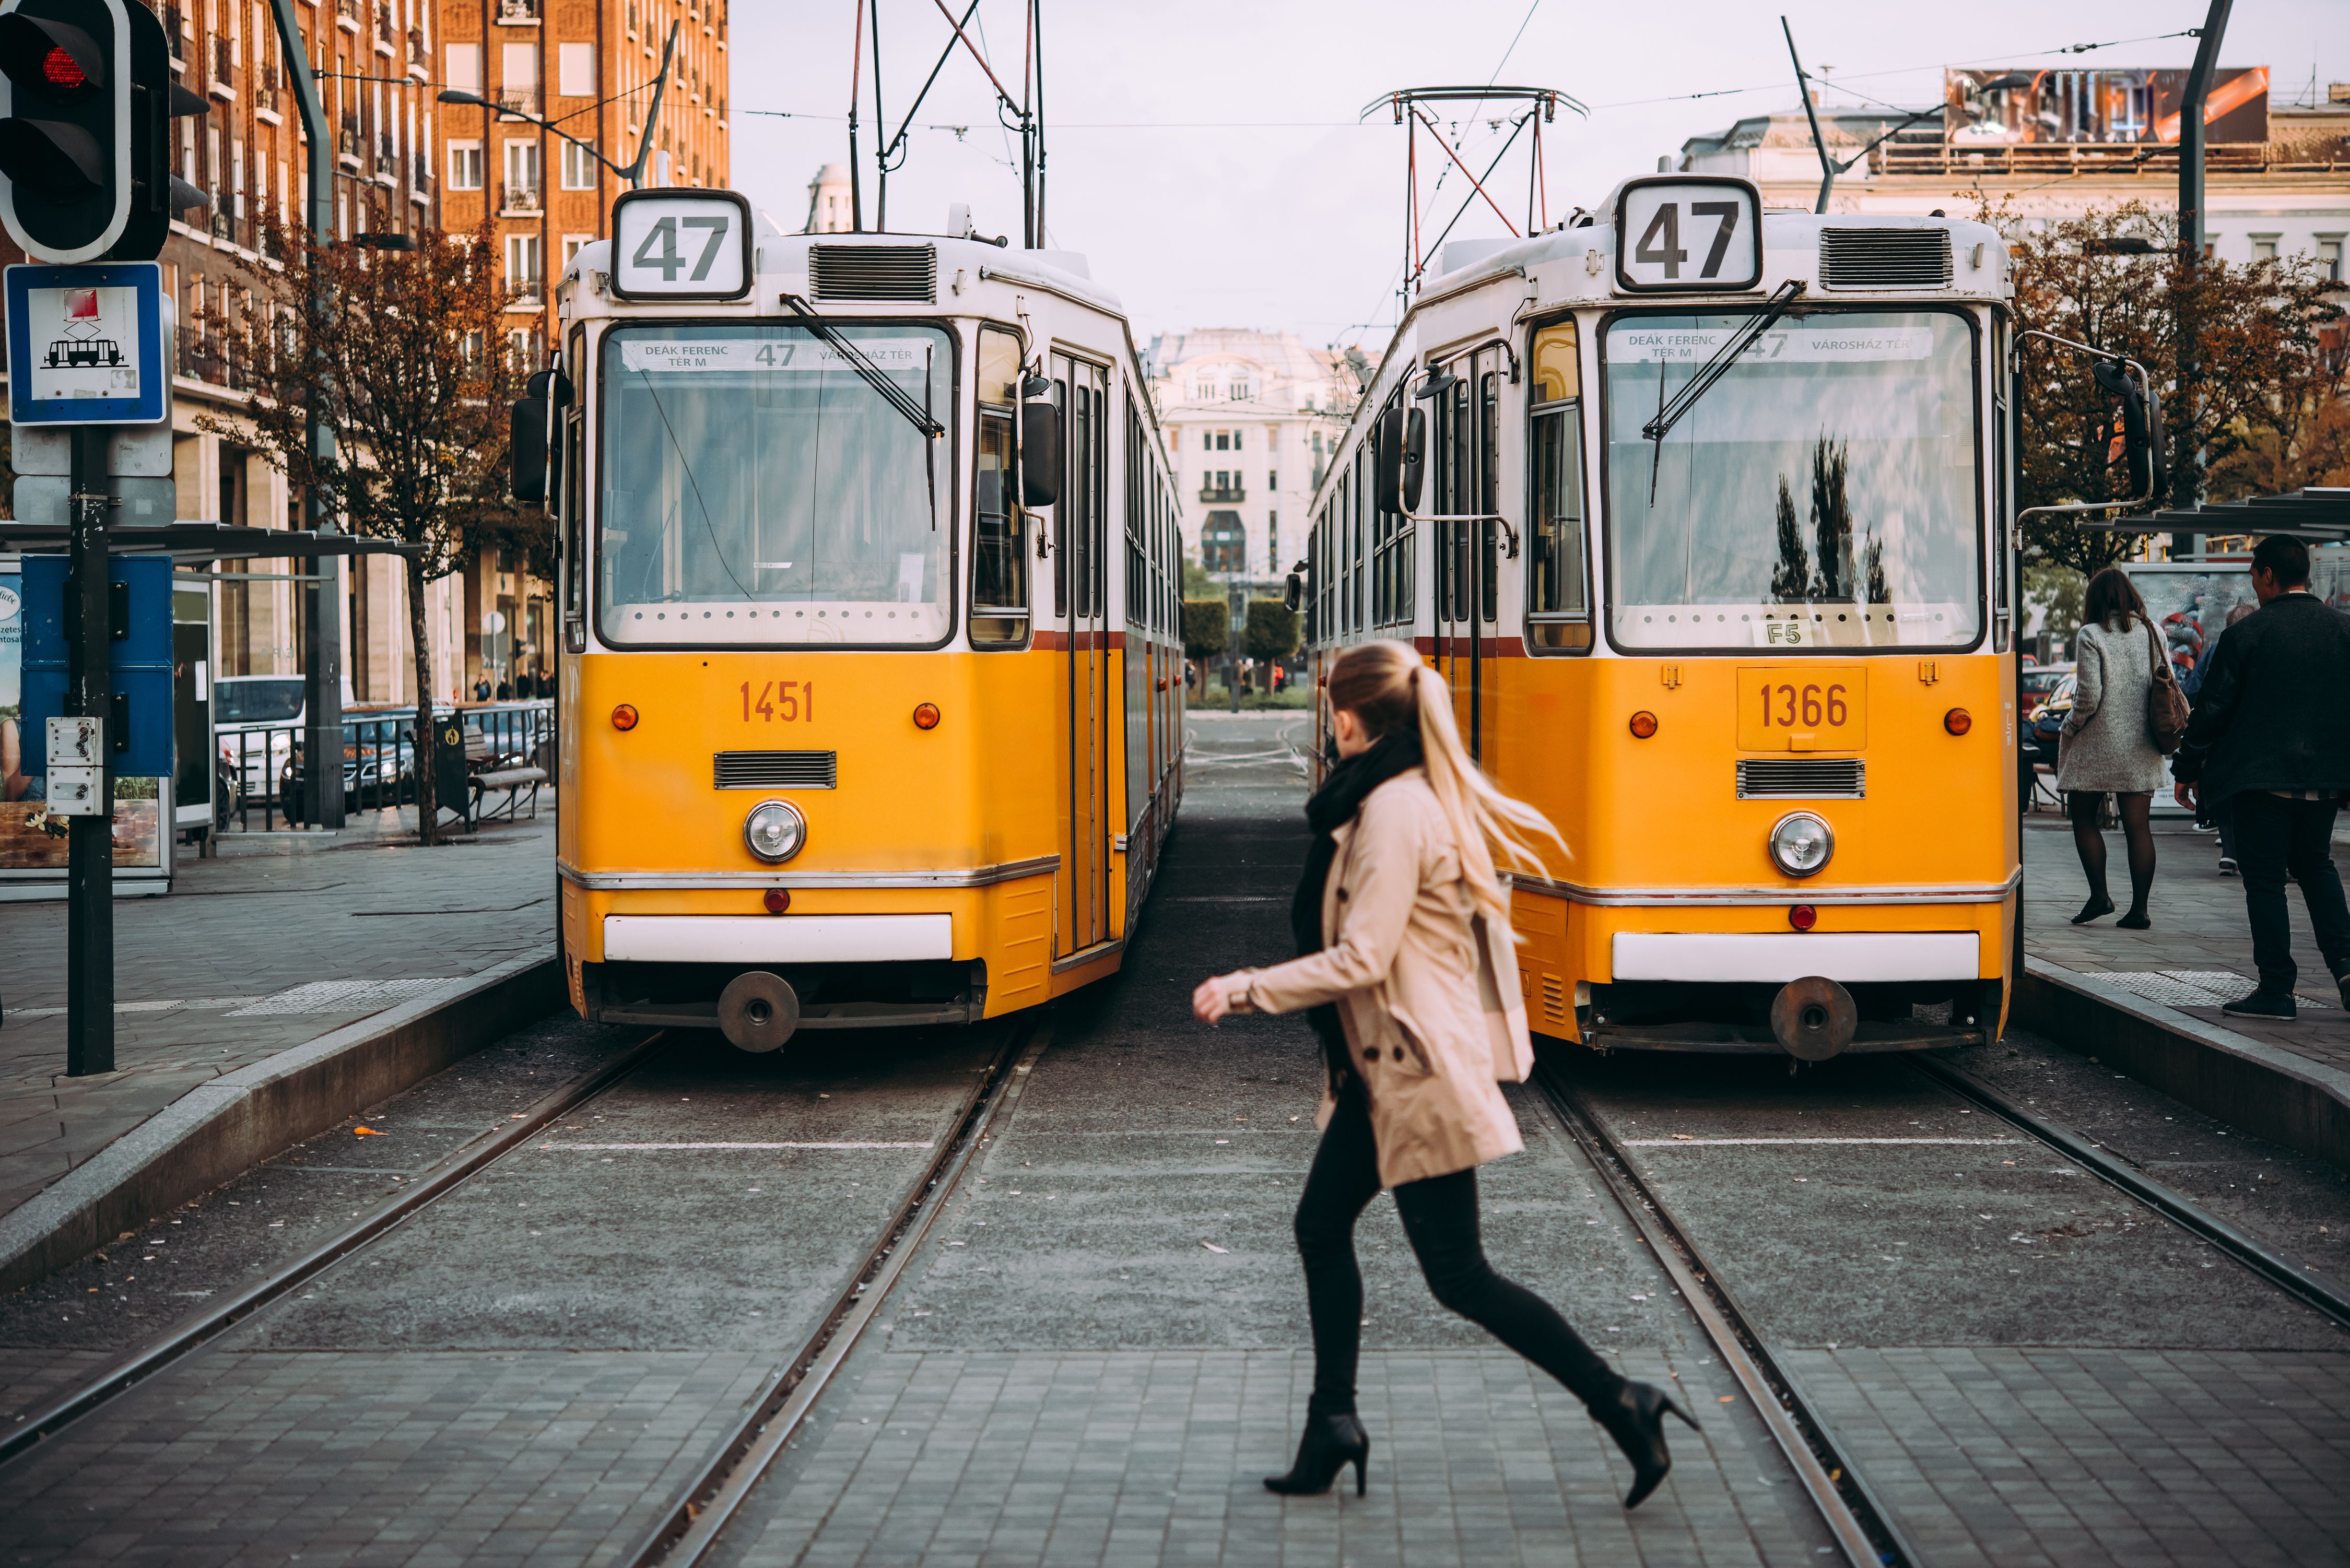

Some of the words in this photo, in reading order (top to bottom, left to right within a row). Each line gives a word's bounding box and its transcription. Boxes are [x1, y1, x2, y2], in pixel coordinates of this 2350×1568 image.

[633, 216, 728, 281] 47
[1635, 202, 1739, 279] 47
[645, 345, 678, 355] DEÁK
[683, 346, 728, 355] FERENC
[1629, 334, 1663, 345] DEÁK
[1668, 336, 1717, 345] FERENC
[1744, 334, 1788, 358] 47
[1812, 339, 1883, 350] VÁROSHÁZ
[1886, 338, 1910, 349] TÉR
[668, 356, 691, 366] TÉR
[755, 344, 796, 367] 47
[889, 349, 912, 359] TÉR
[1652, 347, 1675, 357] TÉR
[1680, 348, 1691, 357] M
[1767, 623, 1801, 644] F5
[741, 681, 812, 722] 1451
[1761, 684, 1847, 727] 1366
